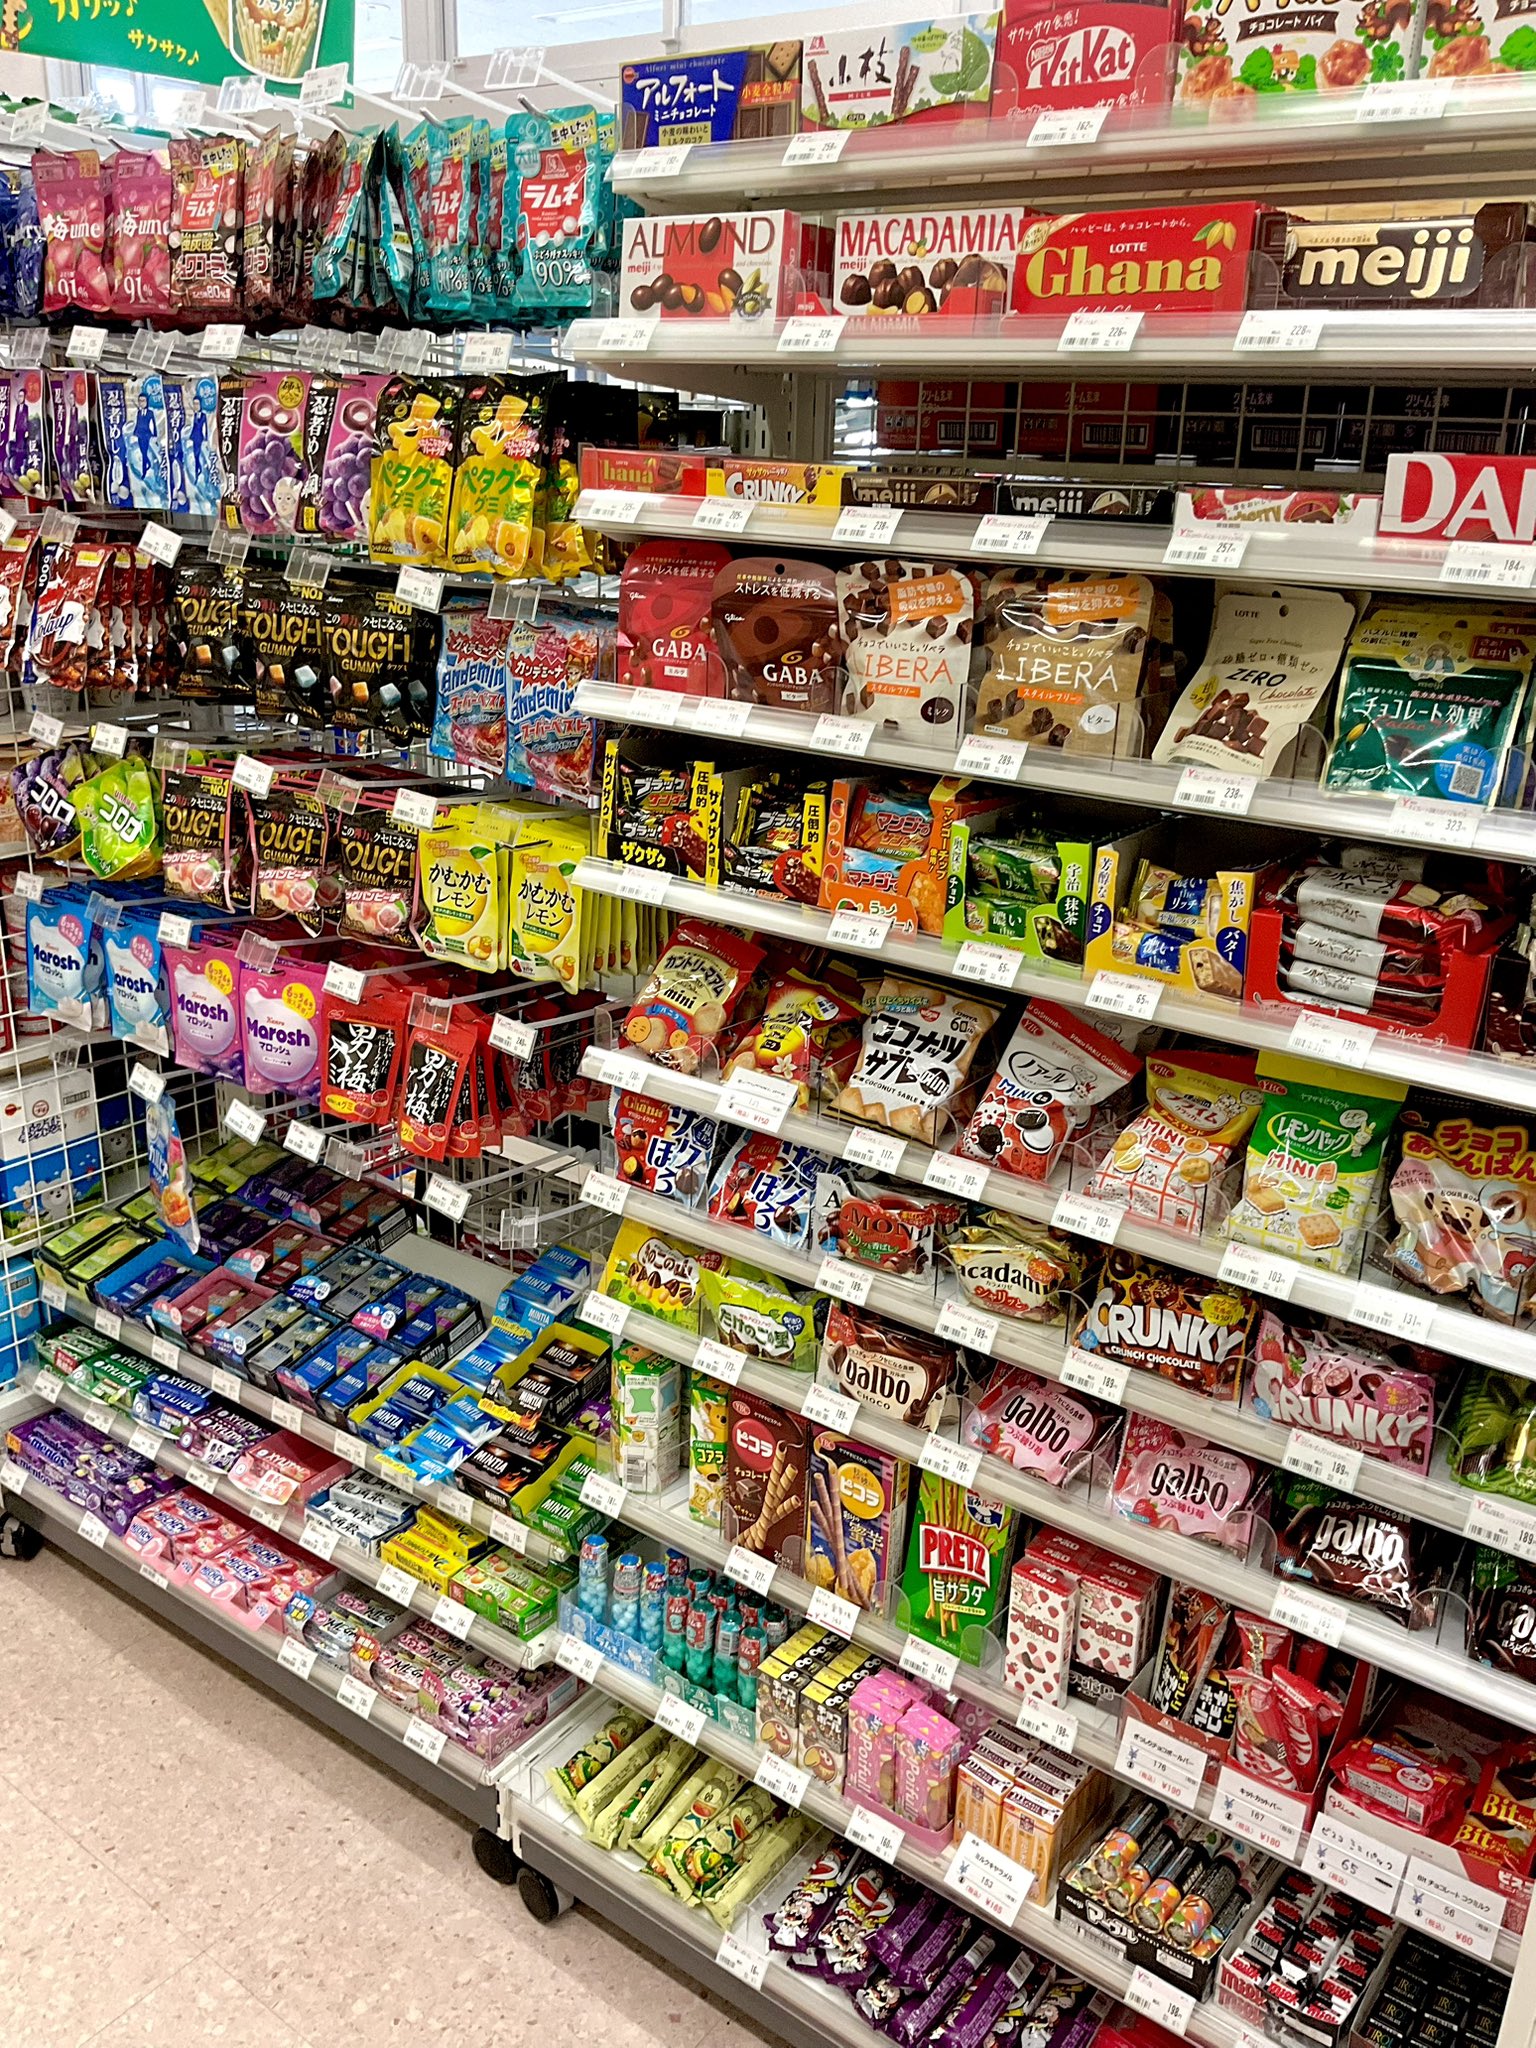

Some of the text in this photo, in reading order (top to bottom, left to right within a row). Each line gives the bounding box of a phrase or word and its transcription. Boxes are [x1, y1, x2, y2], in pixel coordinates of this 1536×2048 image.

[1248, 17, 1301, 35] チョコレート
[128, 29, 188, 61] サクサク
[636, 69, 735, 109] アルフォート
[654, 104, 717, 123] ミニチョコレート
[524, 184, 579, 208] ラムネ
[186, 200, 215, 218] ラムネ
[629, 216, 776, 262] ALMOND
[840, 213, 1016, 257] MACADAMIA
[1110, 242, 1148, 254] LOTTE
[627, 262, 652, 276] meiji
[840, 260, 867, 271] meiji
[1026, 245, 1222, 299] Ghana
[1300, 228, 1474, 299] meiji
[391, 491, 416, 509] グミ
[725, 472, 805, 504] CRUNKY
[474, 493, 498, 514] グミ
[642, 563, 717, 579] ストレスを低減する
[735, 581, 822, 600] ストレスを低減する
[1234, 609, 1259, 619] LOTTE
[245, 610, 322, 646] TOUGH
[259, 641, 298, 657] GUMMY
[322, 626, 411, 663] TOUGH
[652, 637, 707, 661] GABA
[341, 659, 383, 675] GUMMY
[763, 663, 824, 686] GABA
[855, 654, 955, 685] LIBERA
[996, 655, 1119, 693] LIBERA
[1224, 668, 1288, 688] ZERO
[1021, 688, 1077, 704] スタイルフリー
[1259, 685, 1318, 701] Chocolate
[1363, 697, 1484, 729] チョコレート効果
[634, 776, 685, 796] ブラック
[697, 771, 709, 809] 圧倒的
[30, 775, 76, 826] コロロ
[99, 793, 143, 844] コロロ
[808, 805, 820, 844] 圧倒的
[263, 850, 300, 864] GUMMY
[620, 841, 667, 869] ザクザク
[429, 863, 491, 895] かむかむ
[1097, 858, 1113, 899] 芳醇な
[436, 888, 476, 909] レモン
[518, 879, 576, 914] かむかむ
[1063, 863, 1082, 927] 宇治 抹茶
[1170, 897, 1198, 911] リッチ
[526, 903, 563, 928] レモン
[992, 909, 1023, 927] 濃い
[1091, 902, 1106, 935] チョコ
[1223, 880, 1245, 962] 焦がし バター
[665, 953, 727, 998] カントリーマアム
[664, 987, 697, 1009] mini
[185, 1015, 213, 1030] マロッシュ
[247, 1017, 310, 1048] Marosh
[258, 1041, 291, 1056] マロッシュ
[870, 1013, 968, 1063] ココナッツ
[1018, 1057, 1069, 1085] ノアール
[864, 1078, 919, 1104] COCONUT SABLE
[998, 1078, 1034, 1102] MINI
[1260, 1080, 1285, 1094] YBC
[1143, 1116, 1184, 1147] MINI
[1277, 1114, 1350, 1152] レモンパック
[1438, 1123, 1524, 1153] チョコ
[1268, 1149, 1315, 1179] MINI
[546, 1249, 578, 1268] MINTIA
[520, 1273, 551, 1294] MINTIA
[527, 1307, 551, 1325] MINTIA
[1087, 1288, 1244, 1362] CRUNKY
[465, 1353, 497, 1374] MINTIA
[545, 1344, 579, 1365] MINTIA
[1111, 1344, 1201, 1371] CRUNCH CHOCOLATE
[102, 1363, 135, 1383] XYLITOL
[167, 1374, 205, 1395] XYLITOL
[846, 1359, 911, 1406] galbo
[403, 1379, 435, 1399] MINTIA
[517, 1377, 551, 1397] MINTIA
[856, 1390, 891, 1411] CHOCO
[1254, 1359, 1428, 1448] CRUNKY
[1001, 1393, 1070, 1453] galbo
[423, 1427, 455, 1450] MINTIA
[735, 1428, 773, 1458] ピコラ
[30, 1436, 68, 1468] mentos
[474, 1451, 508, 1474] MINTIA
[697, 1448, 724, 1463] コアラ
[734, 1466, 769, 1482] チョコレート
[839, 1476, 881, 1507] ピコラ
[1149, 1462, 1229, 1512] galbo
[541, 1499, 574, 1520] MINTIA
[1315, 1512, 1405, 1564] galbo
[922, 1525, 989, 1578] PRETZ
[1029, 1567, 1058, 1585] アポロ
[932, 1578, 986, 1606] 旨サラダ
[1010, 1611, 1059, 1644] アポロ
[1079, 1616, 1133, 1648] アポロ
[1153, 1759, 1168, 1772] 176
[1250, 1809, 1265, 1823] 167
[1482, 1792, 1519, 1821] Bit
[1456, 1823, 1492, 1849] Bit
[1341, 1859, 1358, 1875] 65
[980, 1875, 994, 1890] 153
[1428, 1879, 1460, 1900] チョコレート
[1443, 1907, 1456, 1919] 56
